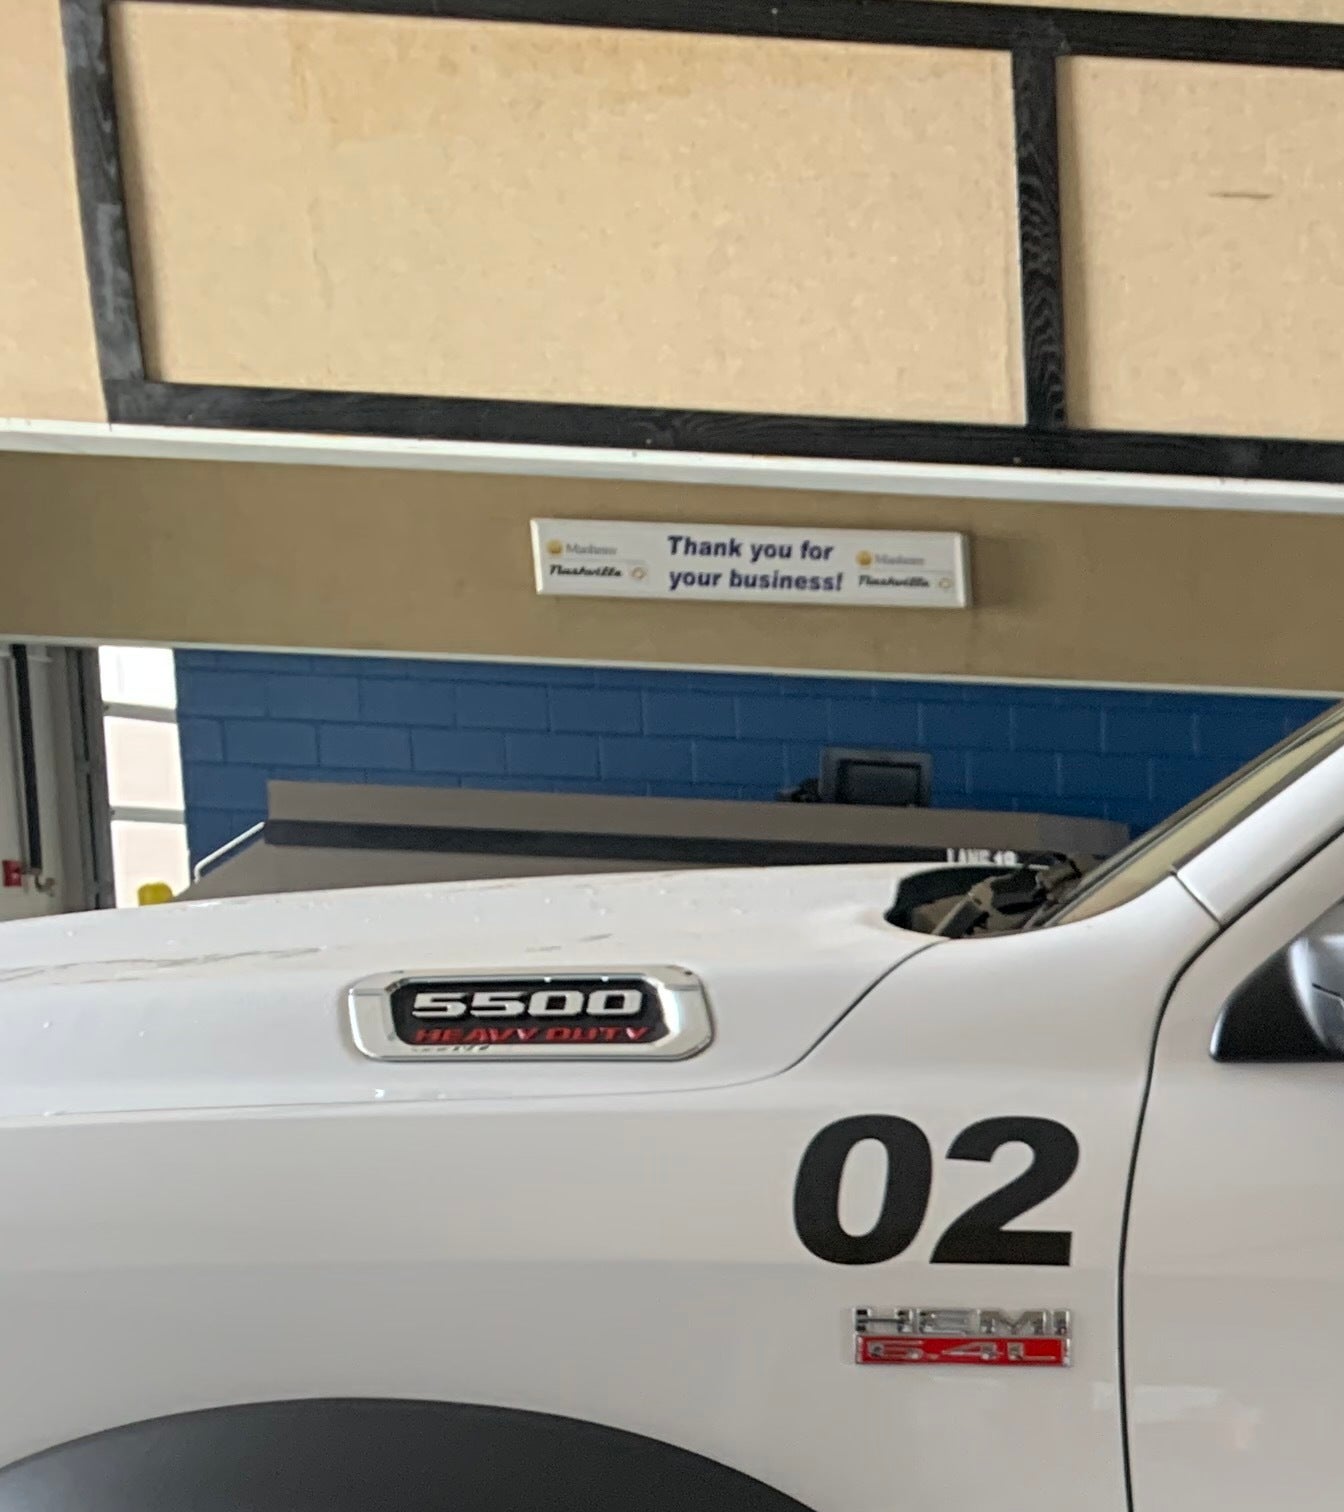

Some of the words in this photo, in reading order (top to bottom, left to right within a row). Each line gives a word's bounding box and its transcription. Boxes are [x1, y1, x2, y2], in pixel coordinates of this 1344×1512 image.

[667, 535, 743, 558] Thank
[750, 543, 793, 563] you
[799, 540, 834, 560] for
[669, 571, 723, 592] your
[729, 568, 844, 592] business!
[411, 989, 644, 1018] 5500
[412, 1027, 538, 1045] HEAVY
[545, 1025, 650, 1042] DUTY
[793, 1114, 1080, 1267] 02
[854, 1308, 1072, 1335] HEMI
